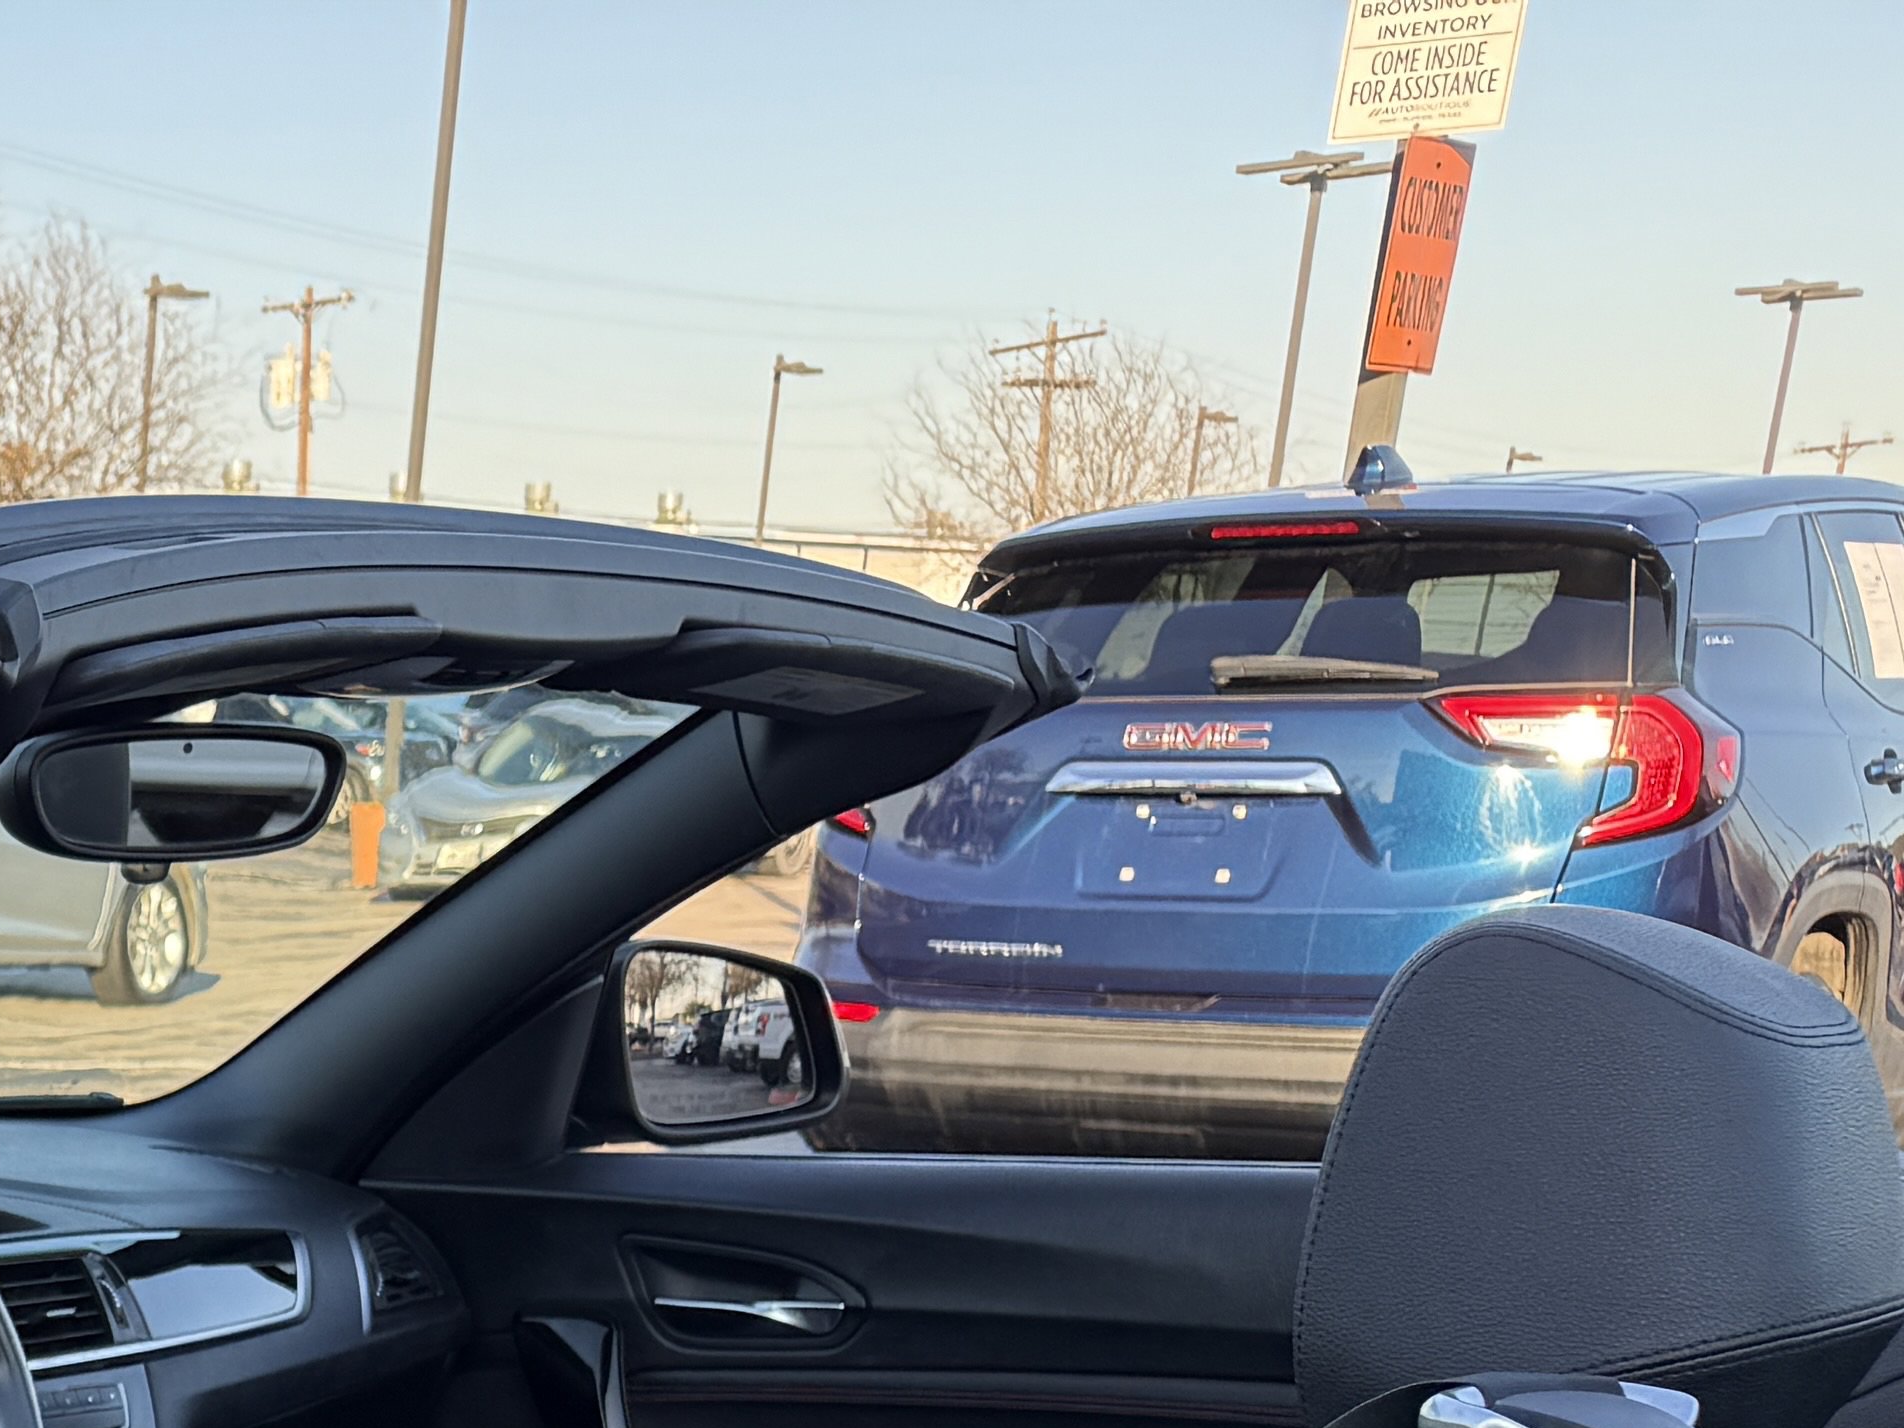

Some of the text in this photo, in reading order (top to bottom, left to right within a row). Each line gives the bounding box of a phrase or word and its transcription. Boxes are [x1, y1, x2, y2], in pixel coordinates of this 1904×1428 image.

[1378, 13, 1492, 40] INVENTORY
[1371, 41, 1488, 76] COME INSIDE
[1349, 68, 1500, 106] FOR ASSISTANCE
[1400, 176, 1465, 240] CUSTOMER
[1386, 269, 1444, 332] PARKING
[1123, 721, 1273, 751] GMC
